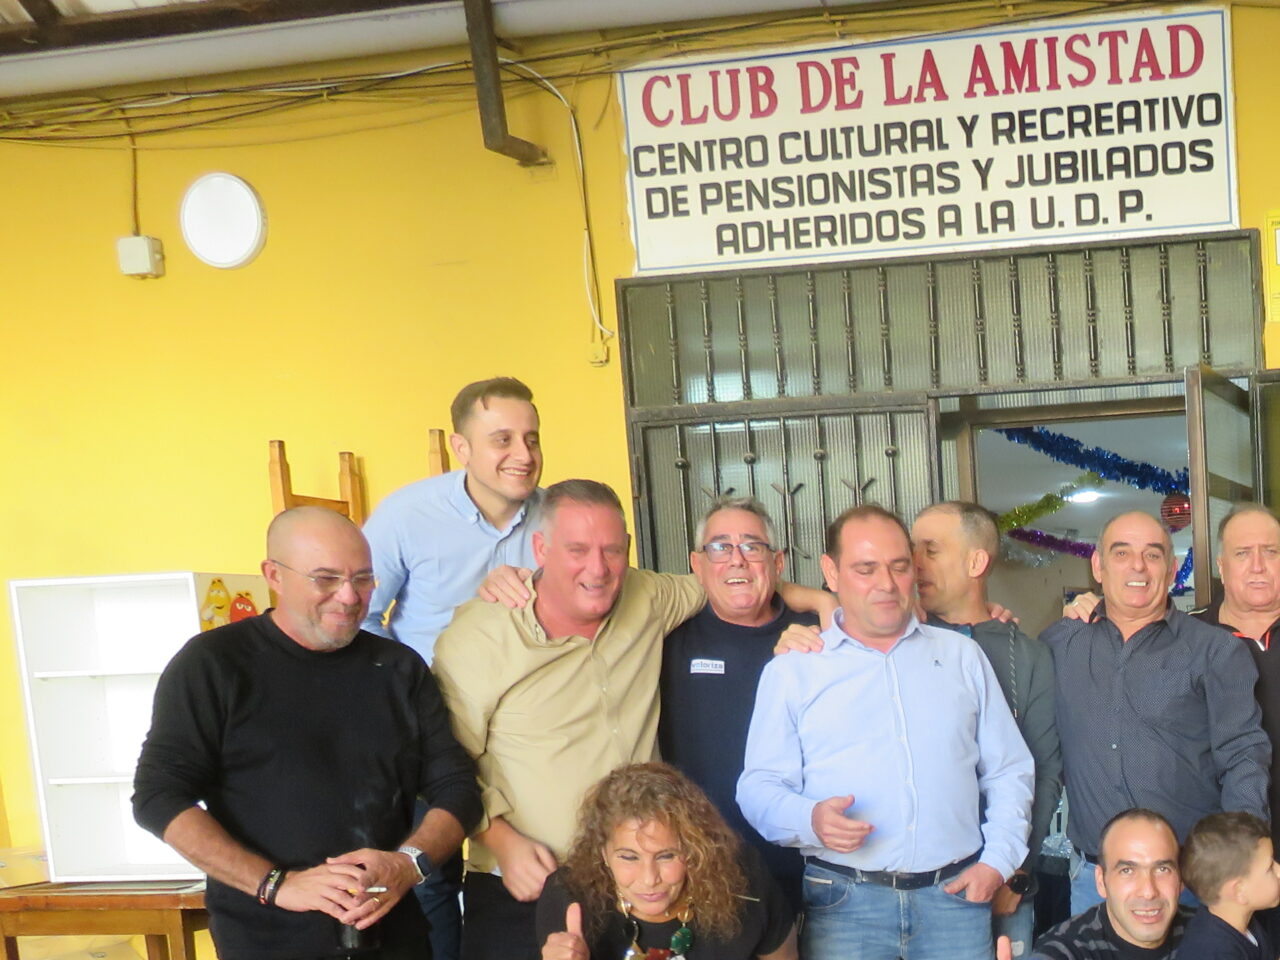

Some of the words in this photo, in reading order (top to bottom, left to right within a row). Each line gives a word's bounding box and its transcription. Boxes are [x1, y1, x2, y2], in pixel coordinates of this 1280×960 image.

[642, 65, 778, 128] CLUB
[797, 56, 863, 114] DE
[880, 48, 949, 106] LA
[964, 23, 1205, 99] AMISTAD
[633, 134, 769, 178] CENTRO
[778, 117, 949, 165] CULTURAL
[957, 114, 980, 148] Y
[991, 92, 1223, 146] RECREATIVO
[646, 184, 690, 220] DE
[700, 161, 961, 215] PENSIONISTAS
[972, 157, 995, 191] Y
[1005, 138, 1214, 189] JUBILADOS
[716, 207, 926, 256] ADHERIDOS
[938, 203, 962, 238] A
[975, 199, 1015, 235] LA
[1030, 195, 1065, 230] U.
[1075, 192, 1109, 226] D.
[1119, 188, 1153, 224] P.
